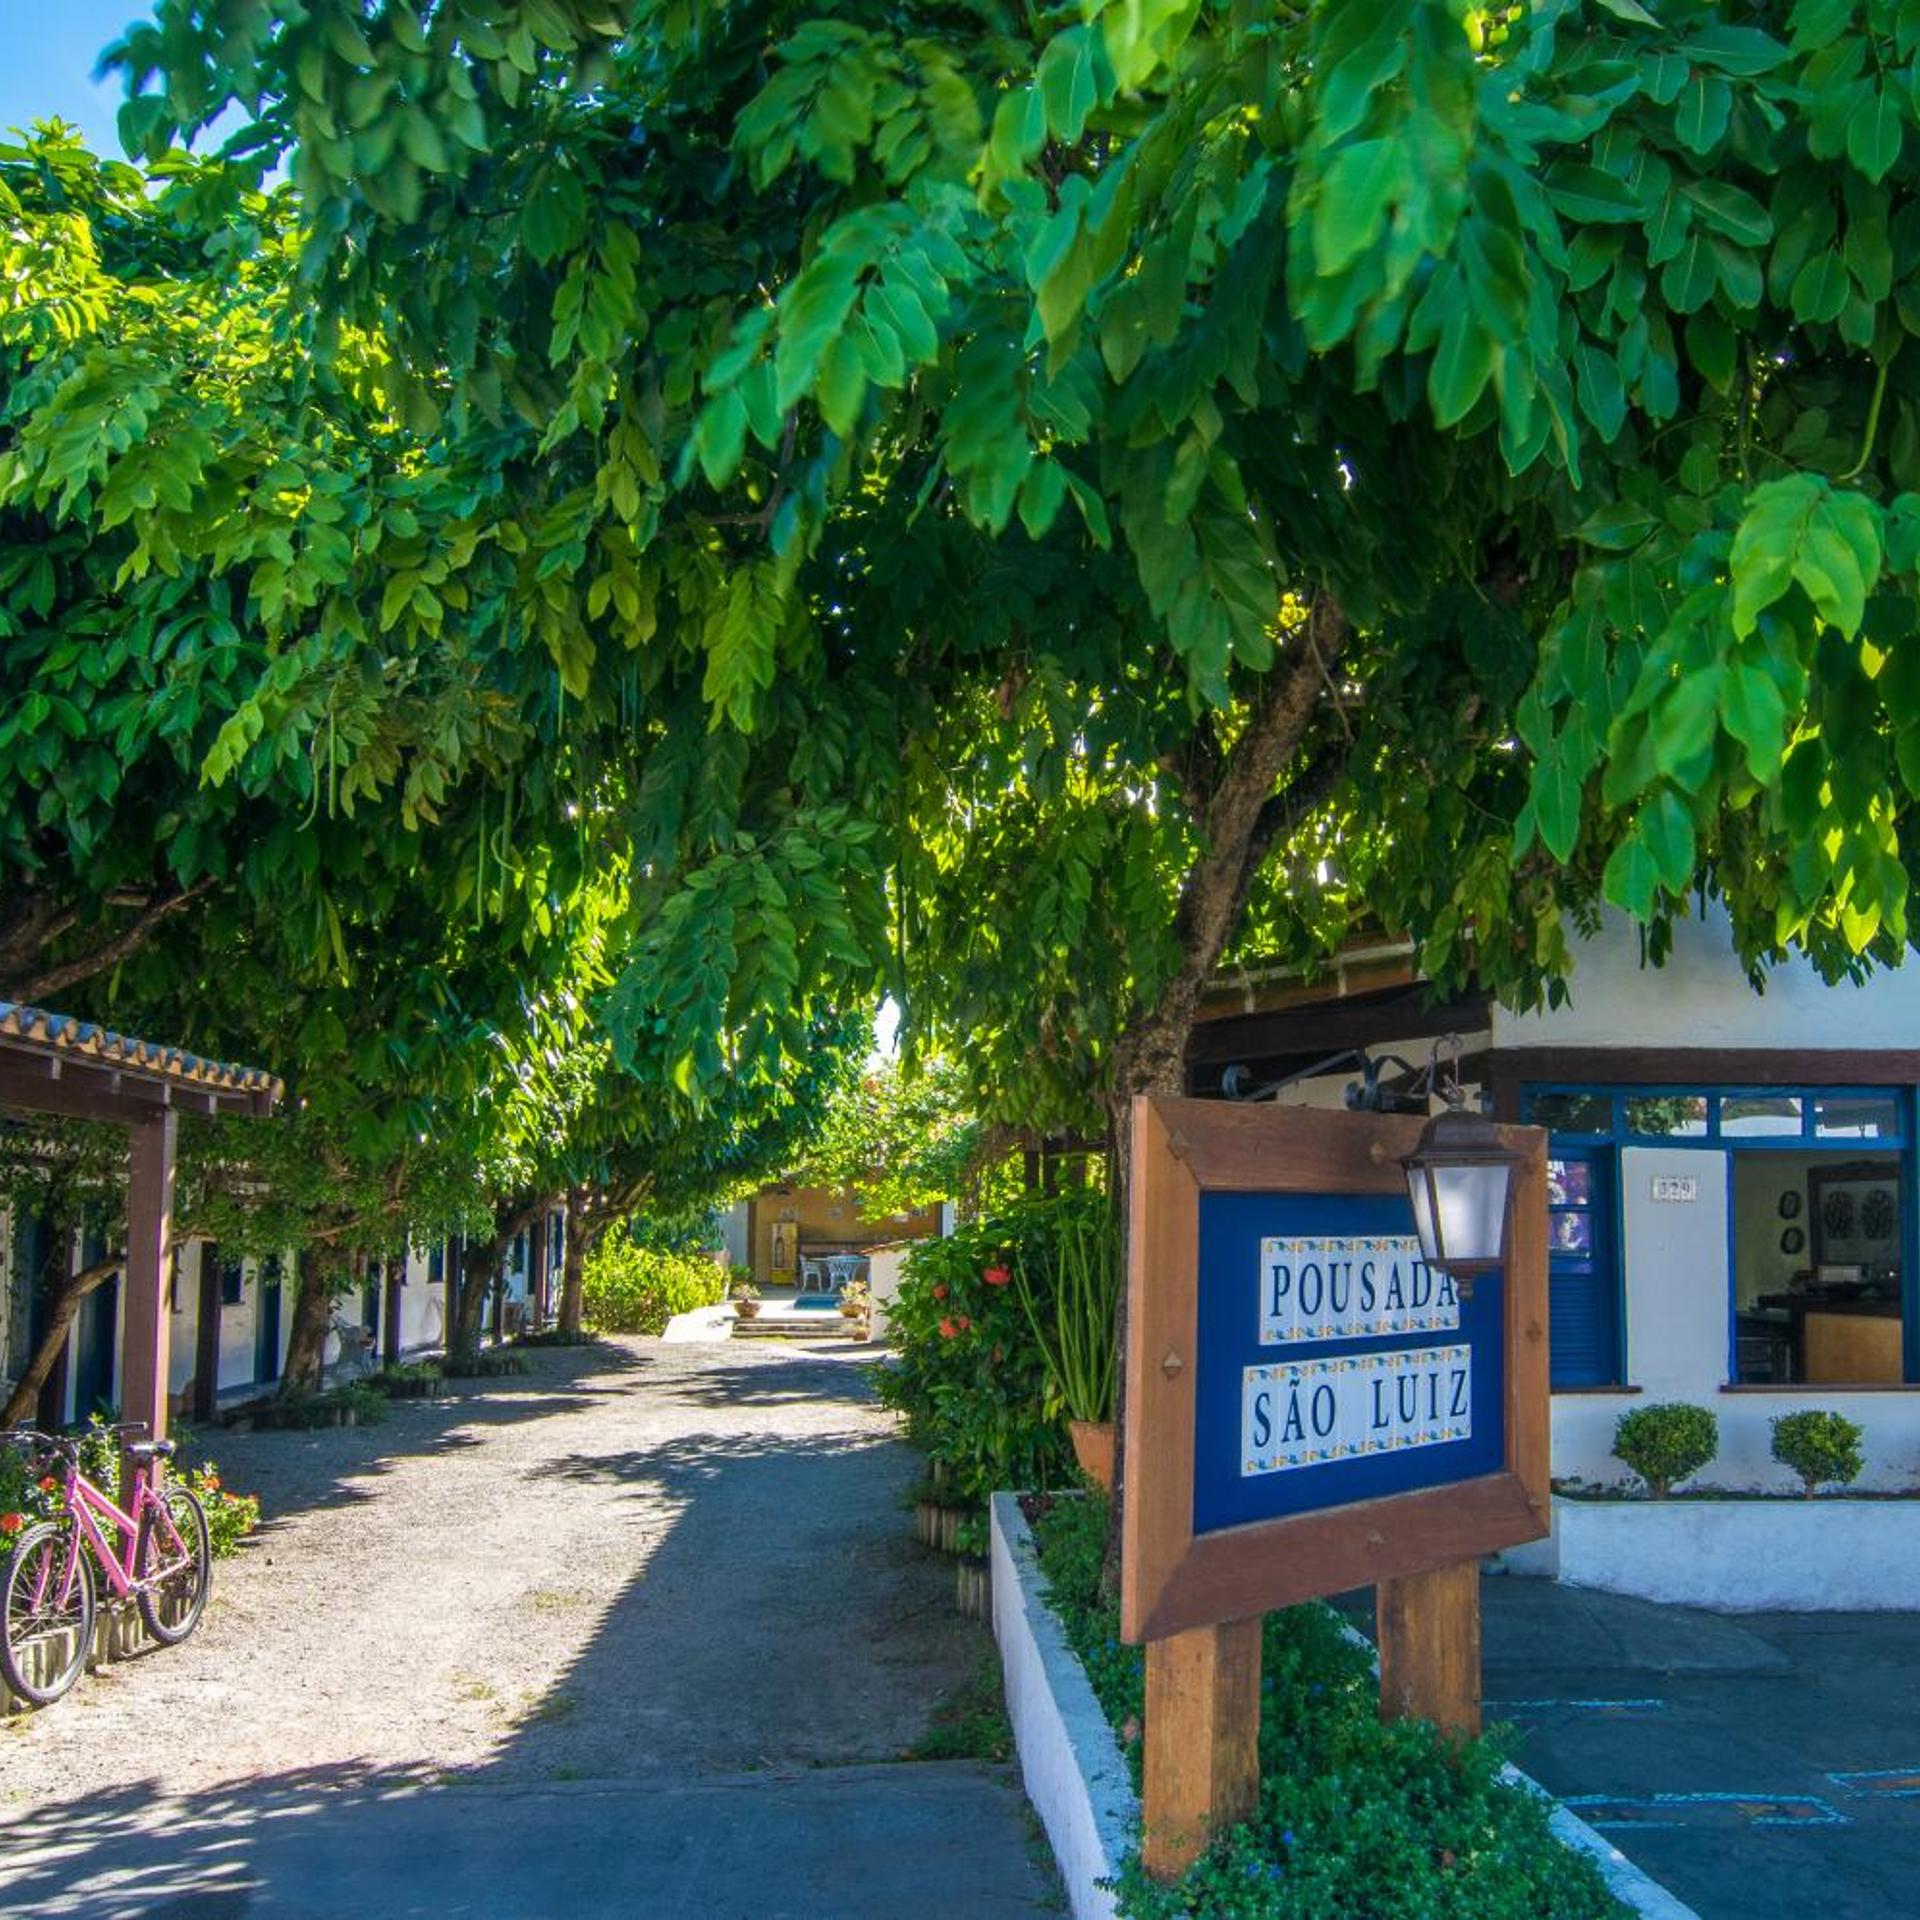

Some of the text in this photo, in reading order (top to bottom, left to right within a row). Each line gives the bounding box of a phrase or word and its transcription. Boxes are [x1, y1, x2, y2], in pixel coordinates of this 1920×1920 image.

[1270, 1261, 1457, 1317] POUSADA
[1254, 1369, 1468, 1448] SÃO LUIZ
